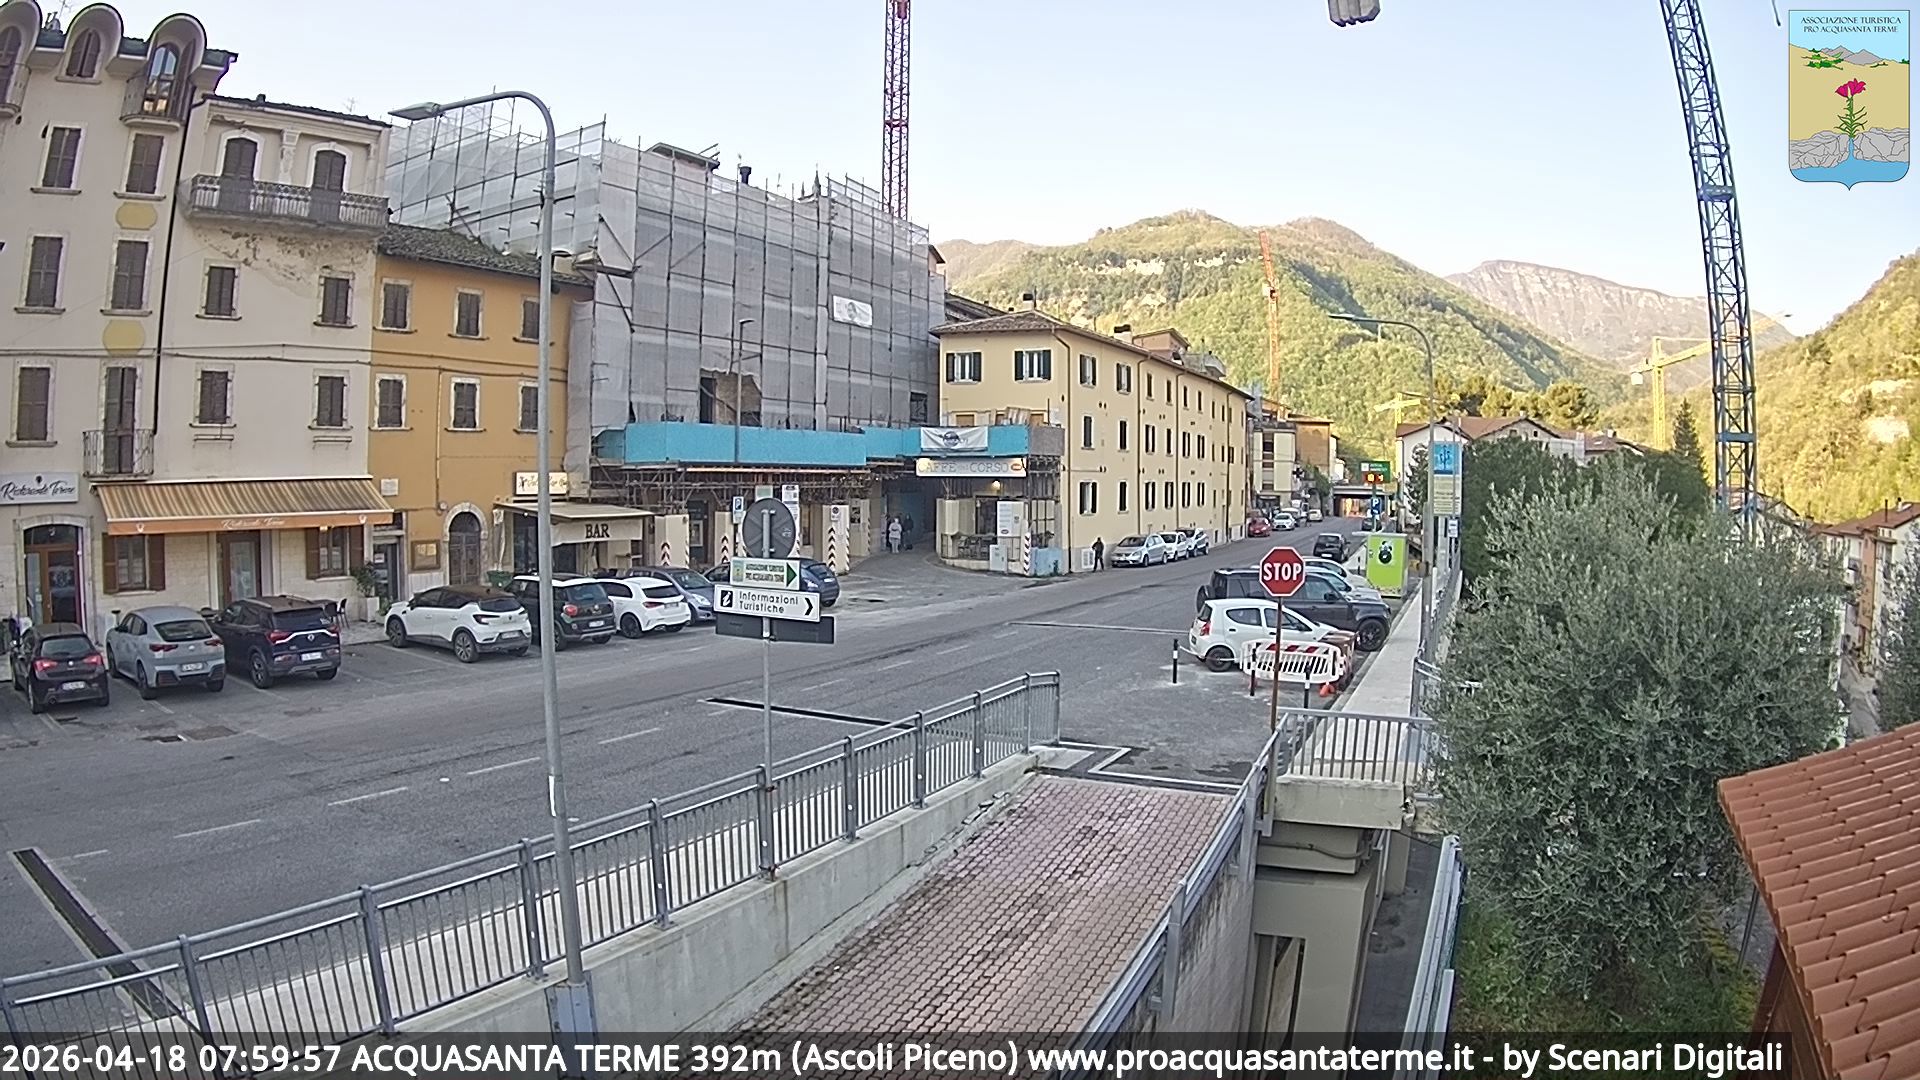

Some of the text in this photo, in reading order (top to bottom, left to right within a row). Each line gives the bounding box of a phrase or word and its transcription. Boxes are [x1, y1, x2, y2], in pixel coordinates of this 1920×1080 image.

[970, 462, 1009, 473] CORSO
[1373, 498, 1380, 507] P
[585, 523, 610, 539] BAR
[1263, 562, 1302, 581] STOP
[739, 591, 799, 605] Informazioni
[739, 601, 785, 614] Turistiche
